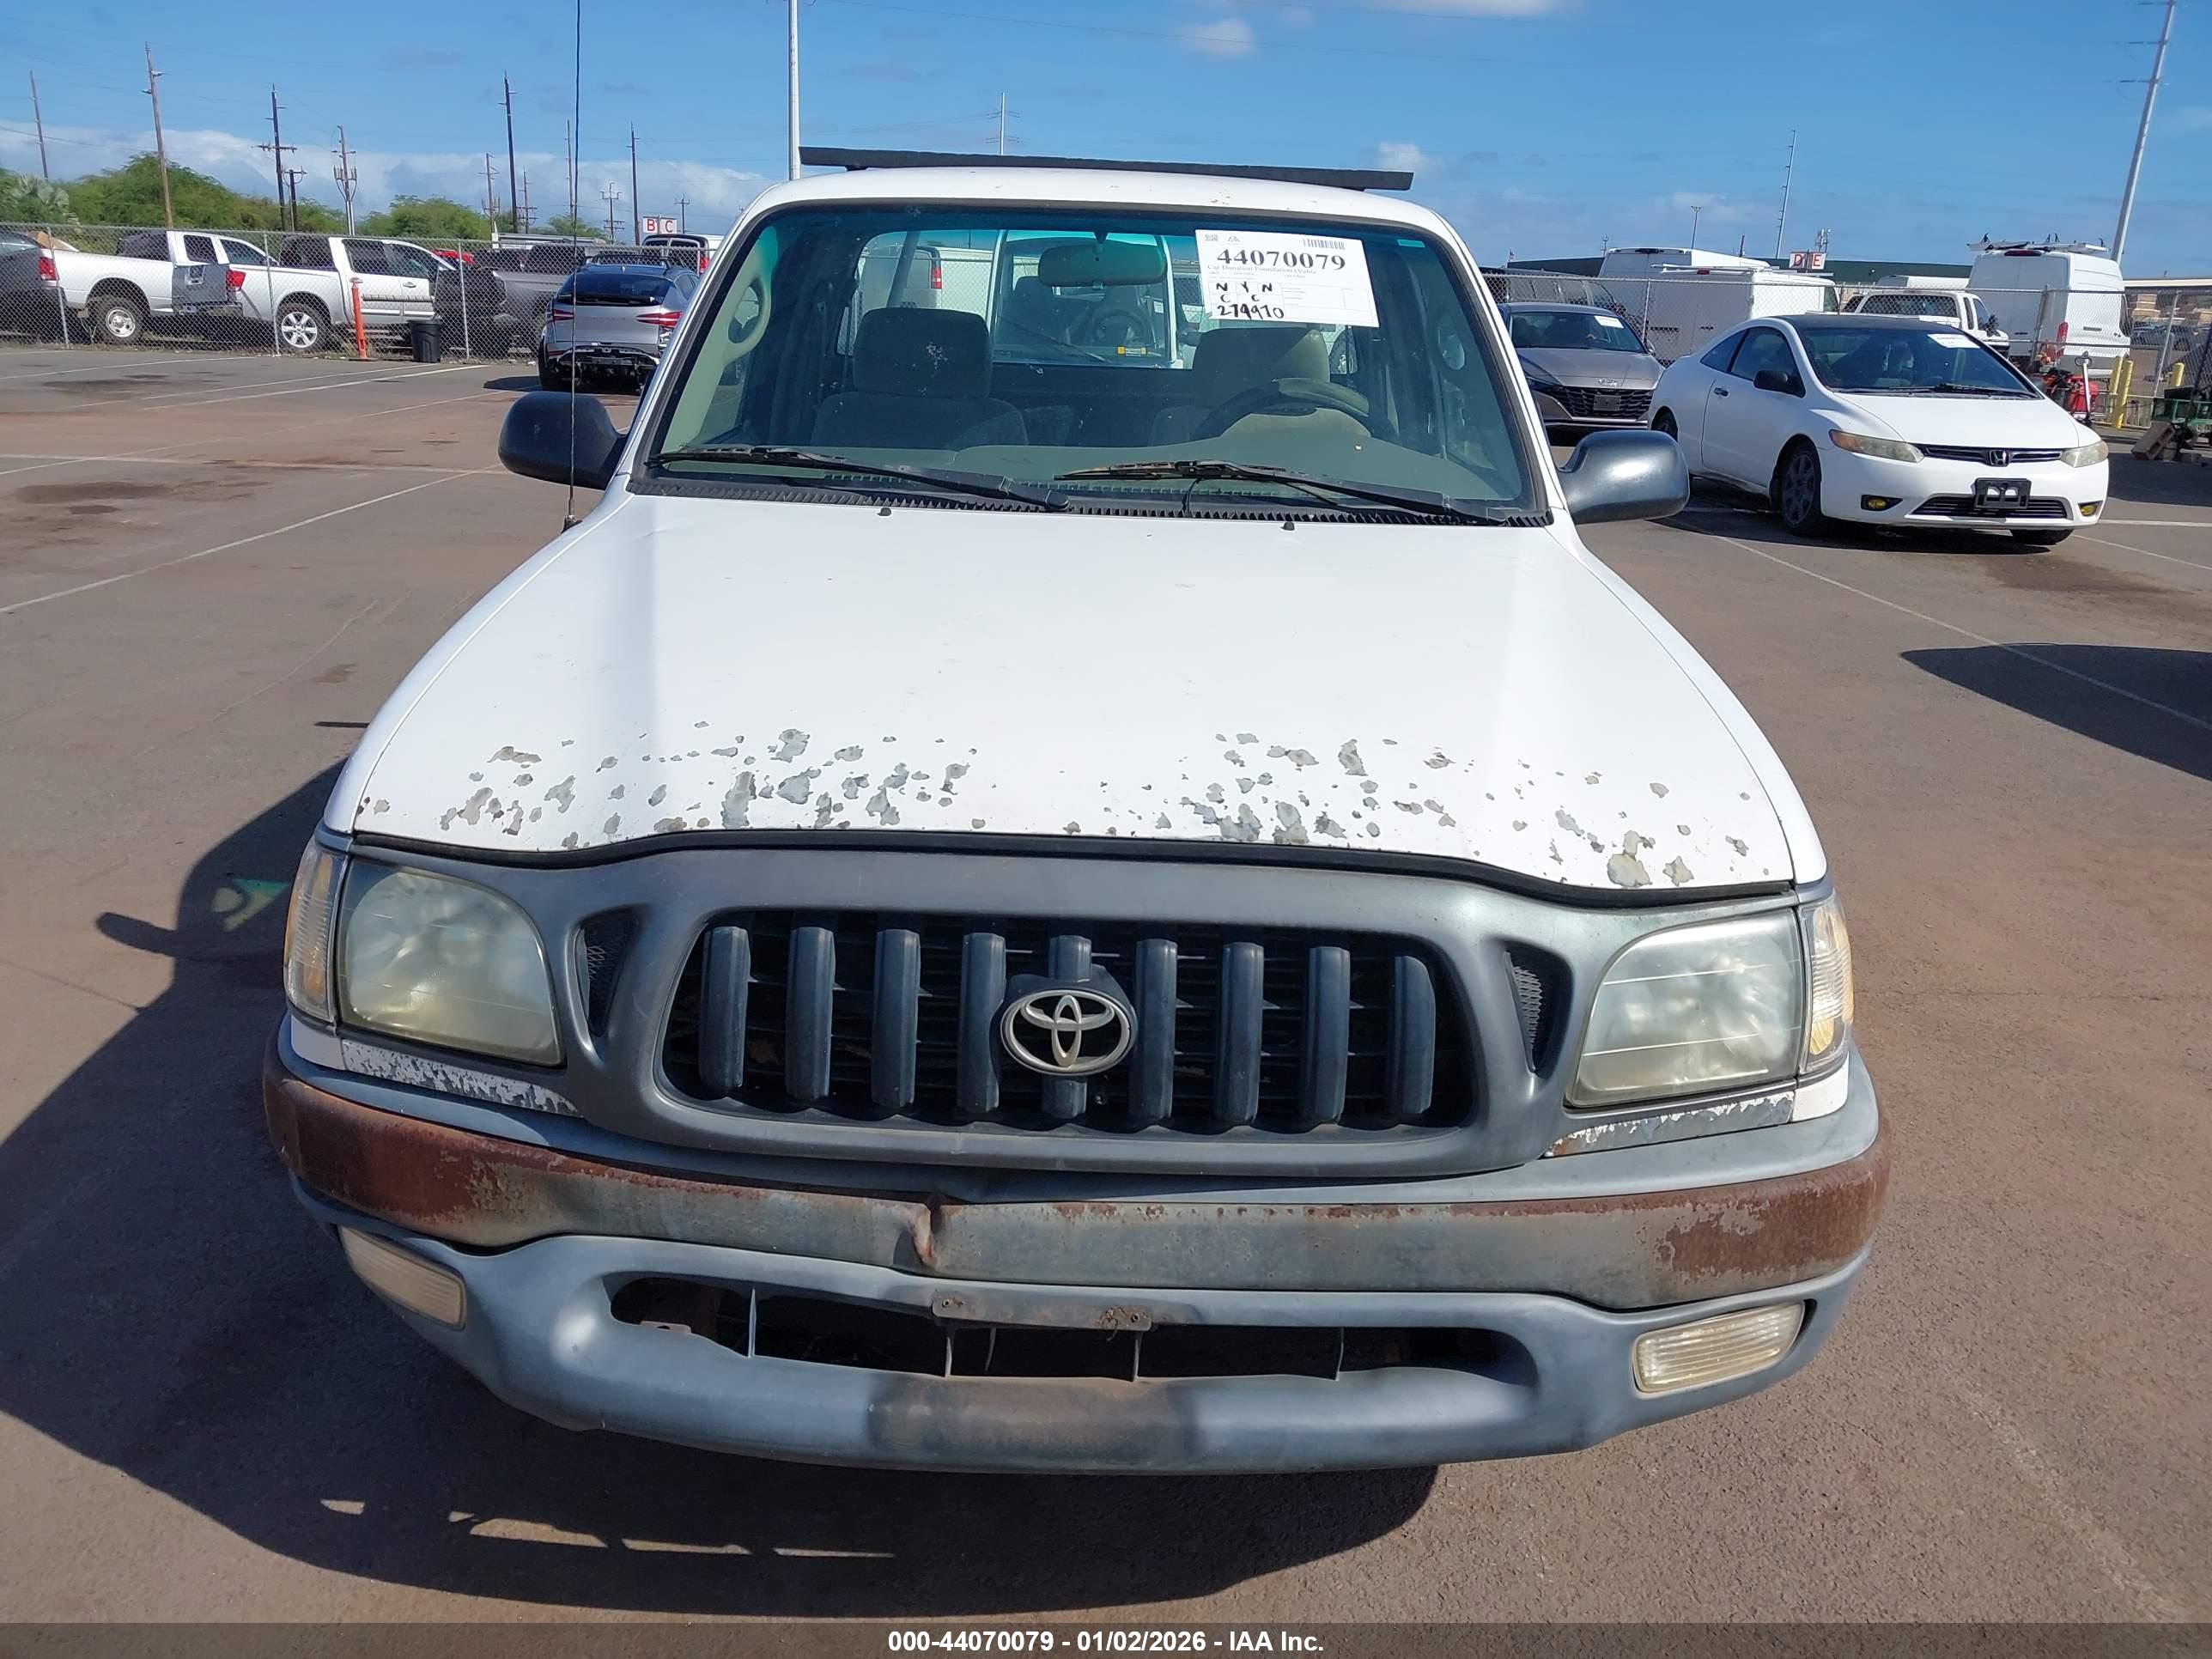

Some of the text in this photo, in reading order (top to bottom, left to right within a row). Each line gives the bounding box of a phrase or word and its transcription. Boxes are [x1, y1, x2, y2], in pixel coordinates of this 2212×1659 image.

[647, 218, 673, 233] B C
[1217, 248, 1346, 270] 44070079
[1794, 253, 1822, 266] D E
[1216, 283, 1228, 292] N
[1240, 281, 1249, 294] Y
[1261, 283, 1273, 293] N
[1219, 294, 1261, 303] C C
